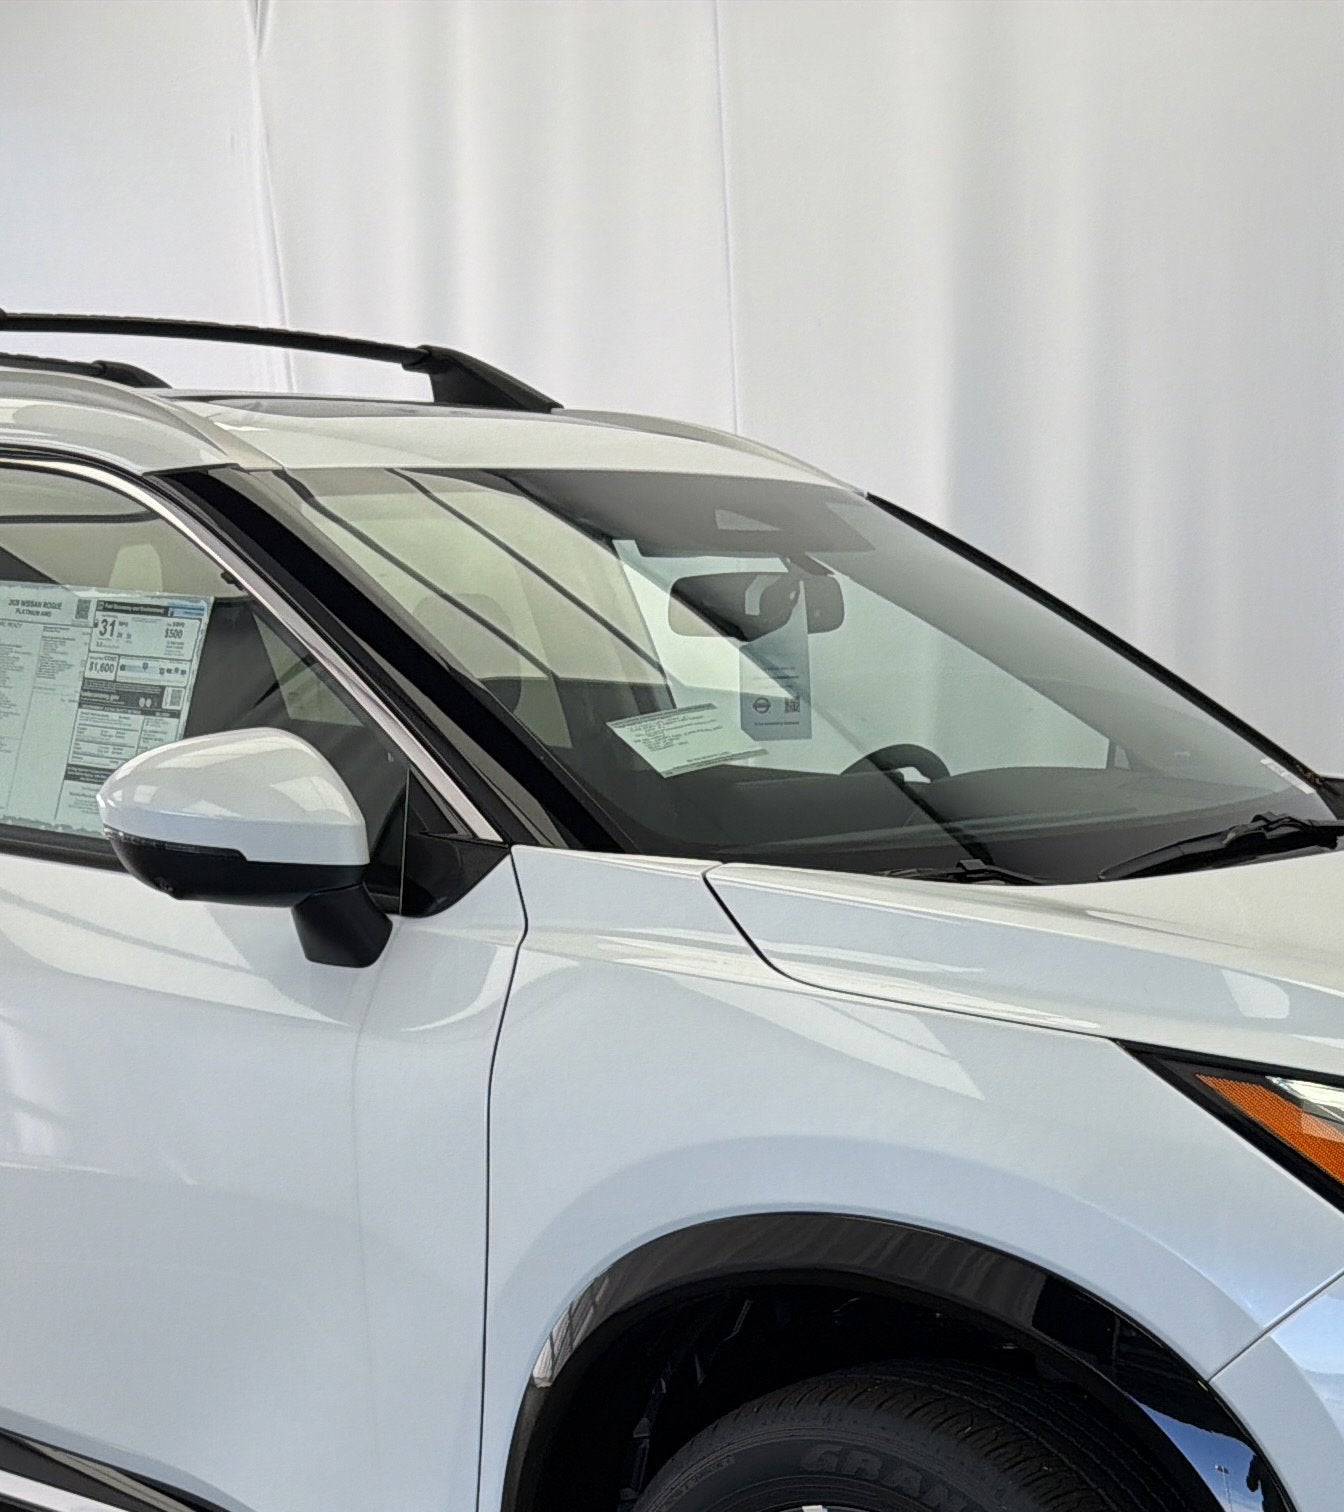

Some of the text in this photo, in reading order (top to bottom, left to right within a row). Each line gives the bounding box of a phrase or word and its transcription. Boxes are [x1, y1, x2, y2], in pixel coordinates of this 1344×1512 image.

[99, 618, 116, 637] 31
[164, 628, 183, 639] $500
[89, 661, 115, 674] $1,600
